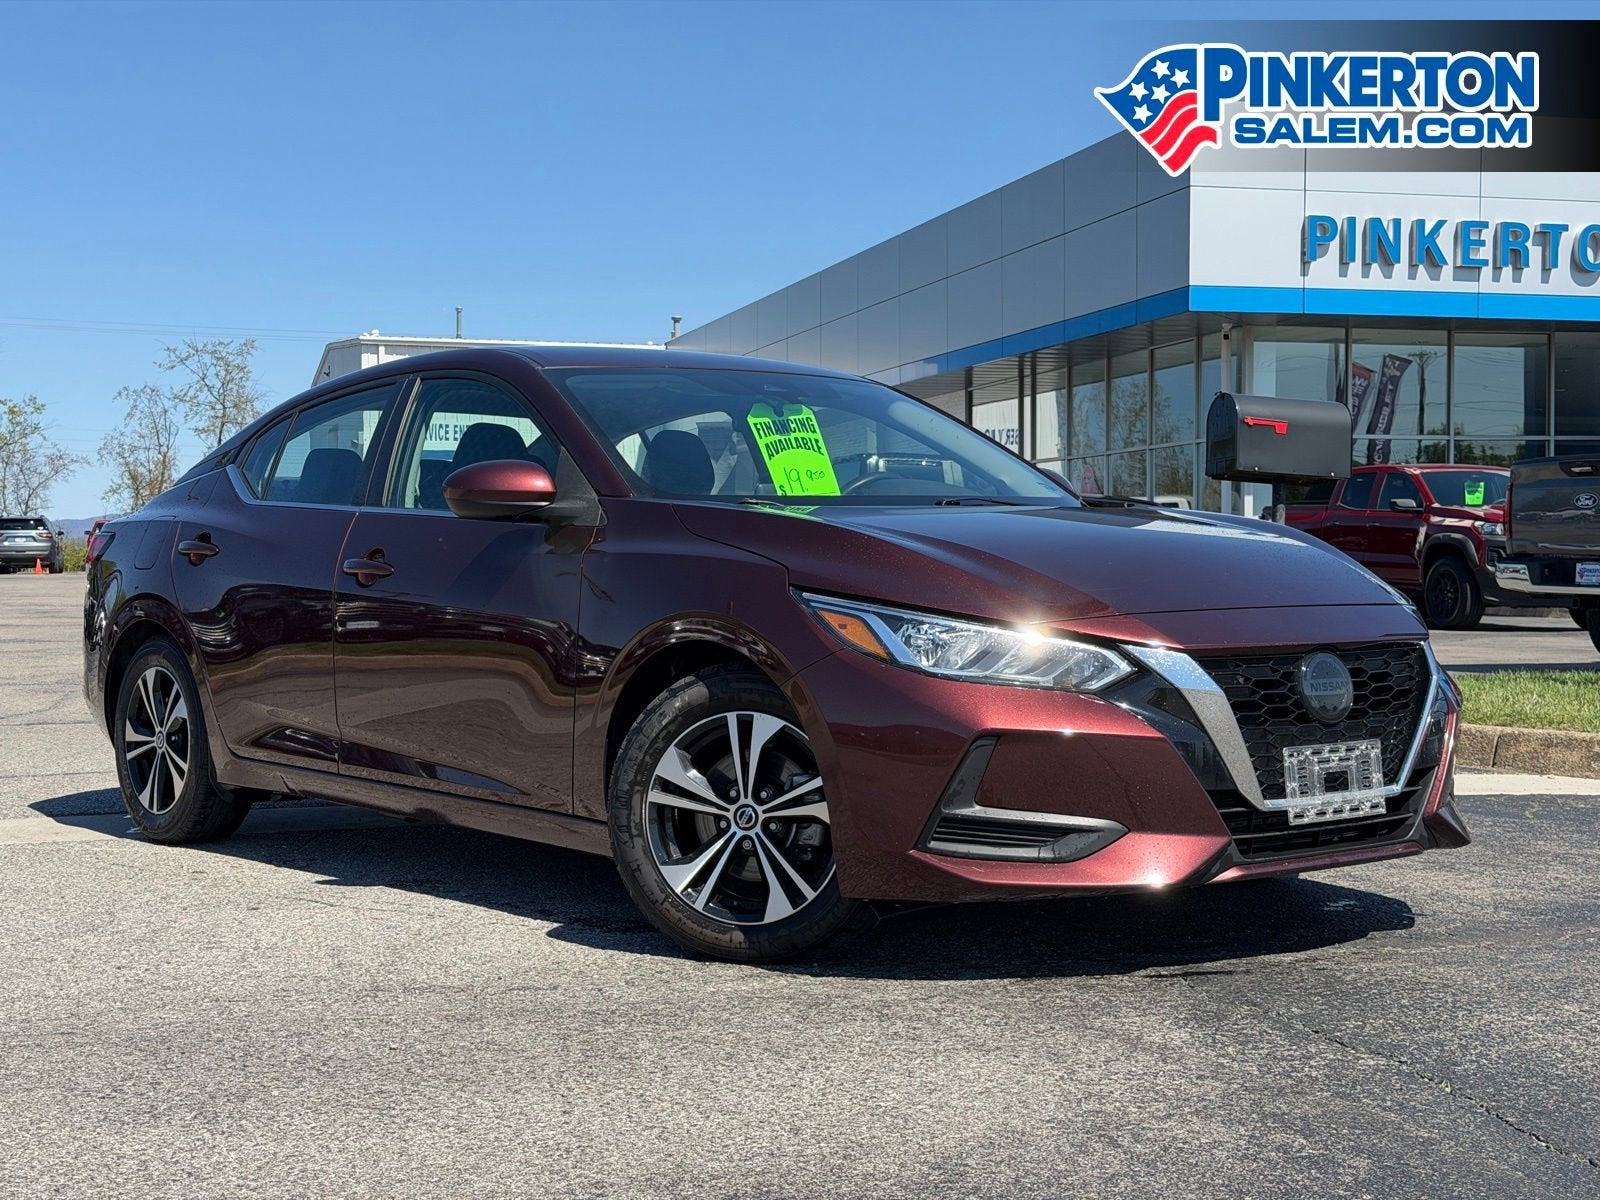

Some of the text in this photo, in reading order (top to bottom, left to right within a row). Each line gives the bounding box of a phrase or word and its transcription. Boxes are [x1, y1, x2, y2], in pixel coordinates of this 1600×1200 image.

[1303, 215, 1600, 272] PINKERTO
[426, 423, 450, 441] VICE
[753, 417, 818, 439] FINANCING
[764, 437, 825, 460] AVAILABLE
[1310, 680, 1347, 693] NISSAN
